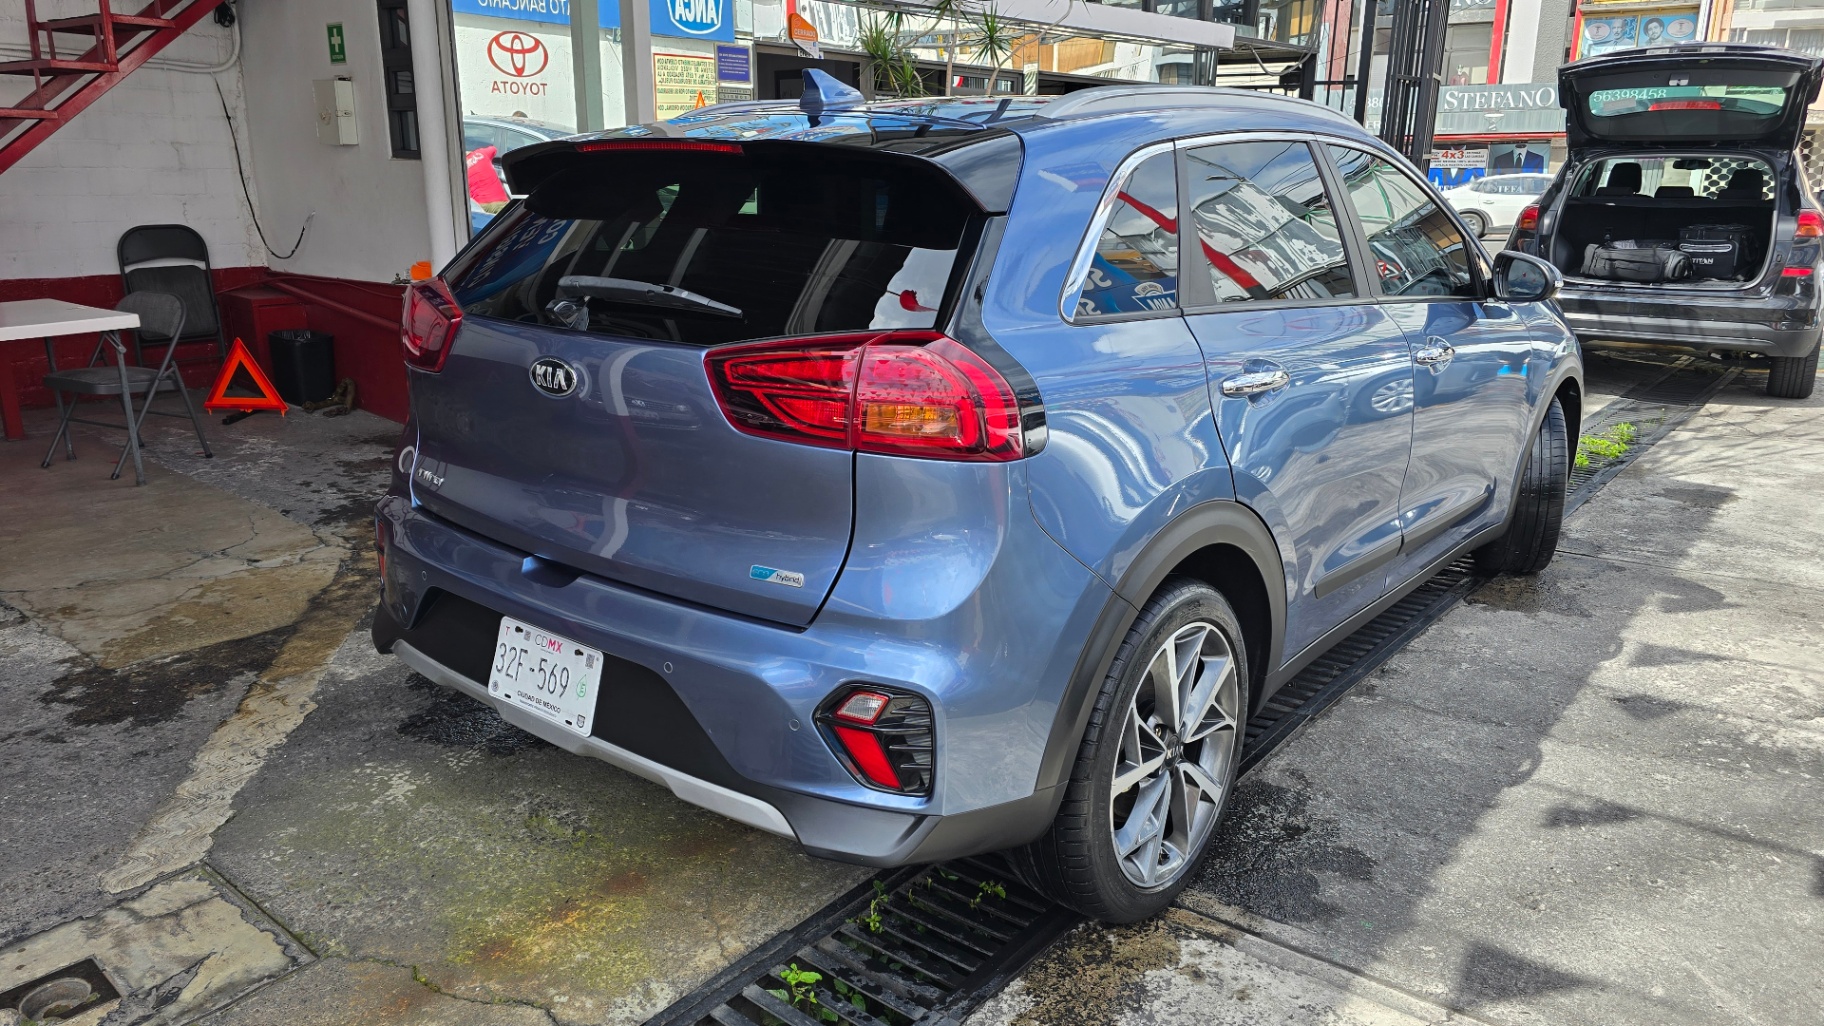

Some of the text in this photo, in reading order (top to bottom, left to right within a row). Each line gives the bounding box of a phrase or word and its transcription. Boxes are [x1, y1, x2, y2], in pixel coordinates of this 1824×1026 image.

[794, 28, 816, 37] CERRADO
[1444, 87, 1555, 109] STEFANO
[1442, 150, 1464, 159] 4x3
[536, 364, 567, 390] KIA
[535, 634, 563, 654] CDMX
[496, 642, 570, 698] 32F-569
[517, 690, 534, 702] CIUDAD
[543, 699, 561, 713] MÉXICO
